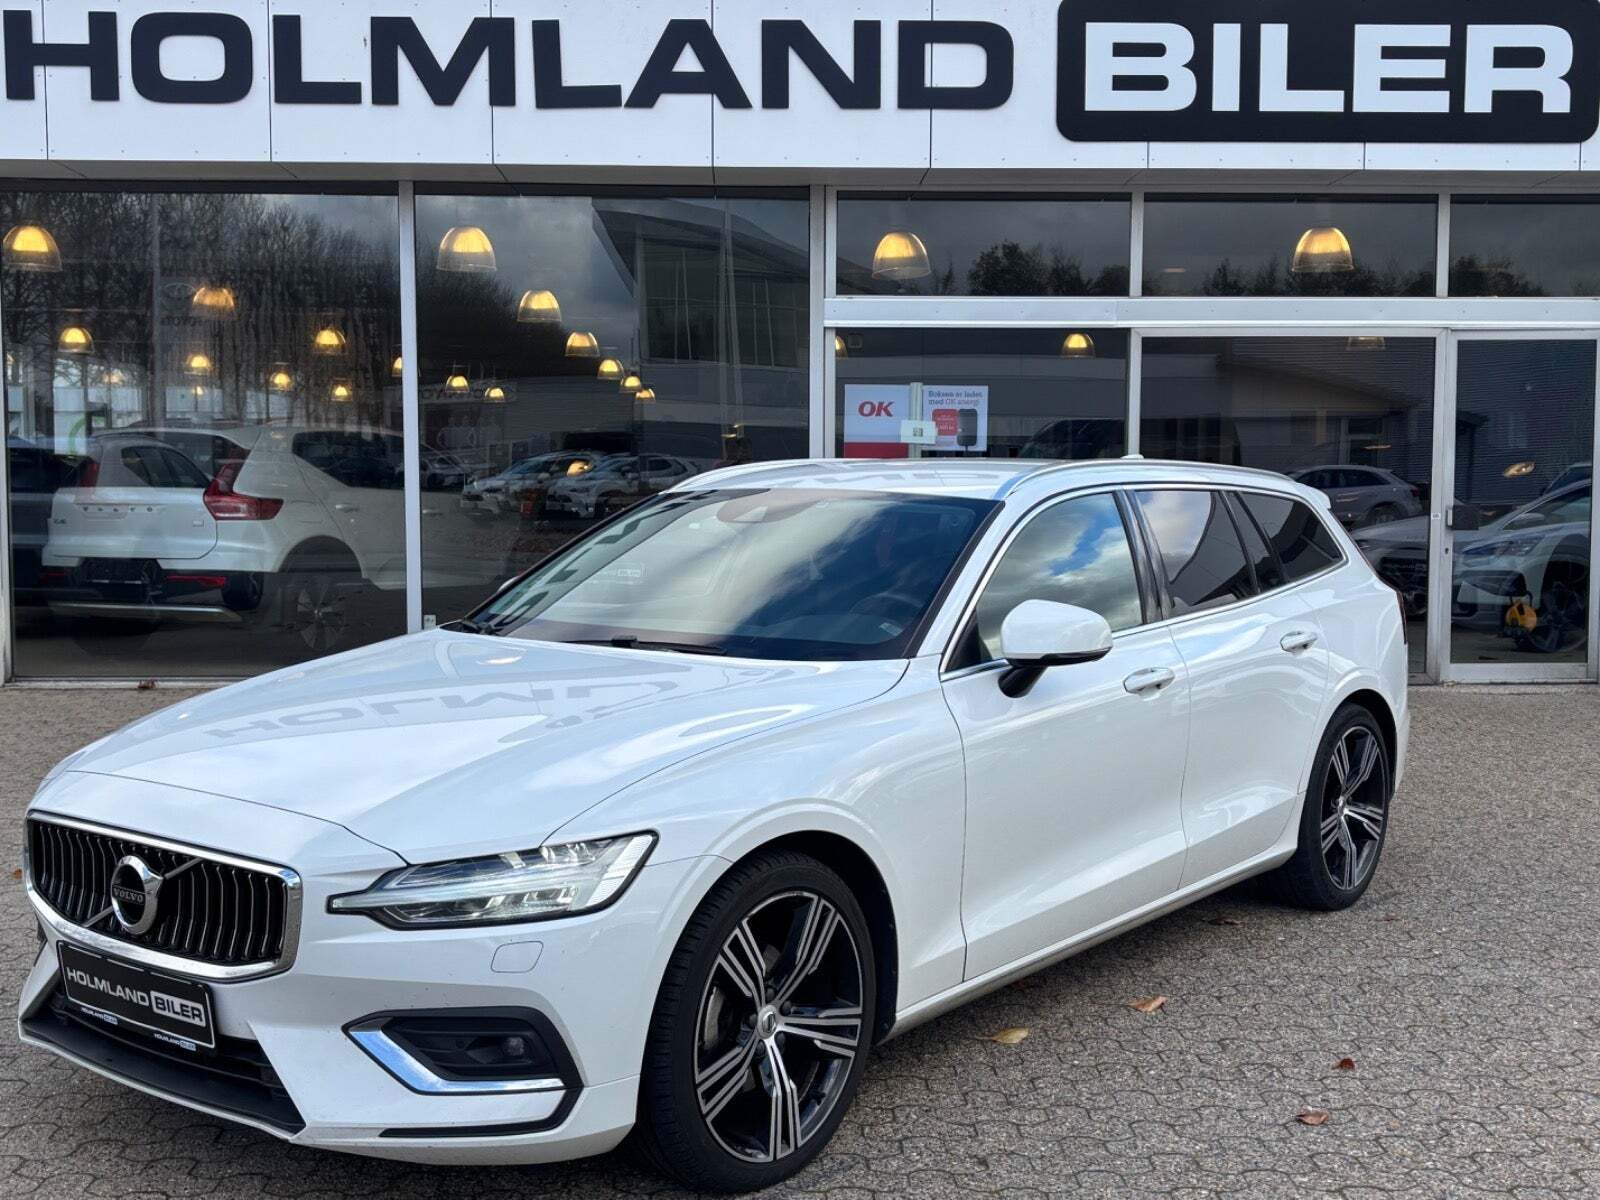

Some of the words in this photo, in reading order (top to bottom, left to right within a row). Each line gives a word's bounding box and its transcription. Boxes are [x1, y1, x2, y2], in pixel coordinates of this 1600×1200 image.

[3, 9, 1014, 109] HOLMLAND
[1085, 22, 1573, 113] BILER
[858, 401, 896, 418] OK
[113, 887, 144, 903] VOLVO
[66, 967, 149, 1007] HOLMLAND
[155, 995, 204, 1022] BILER
